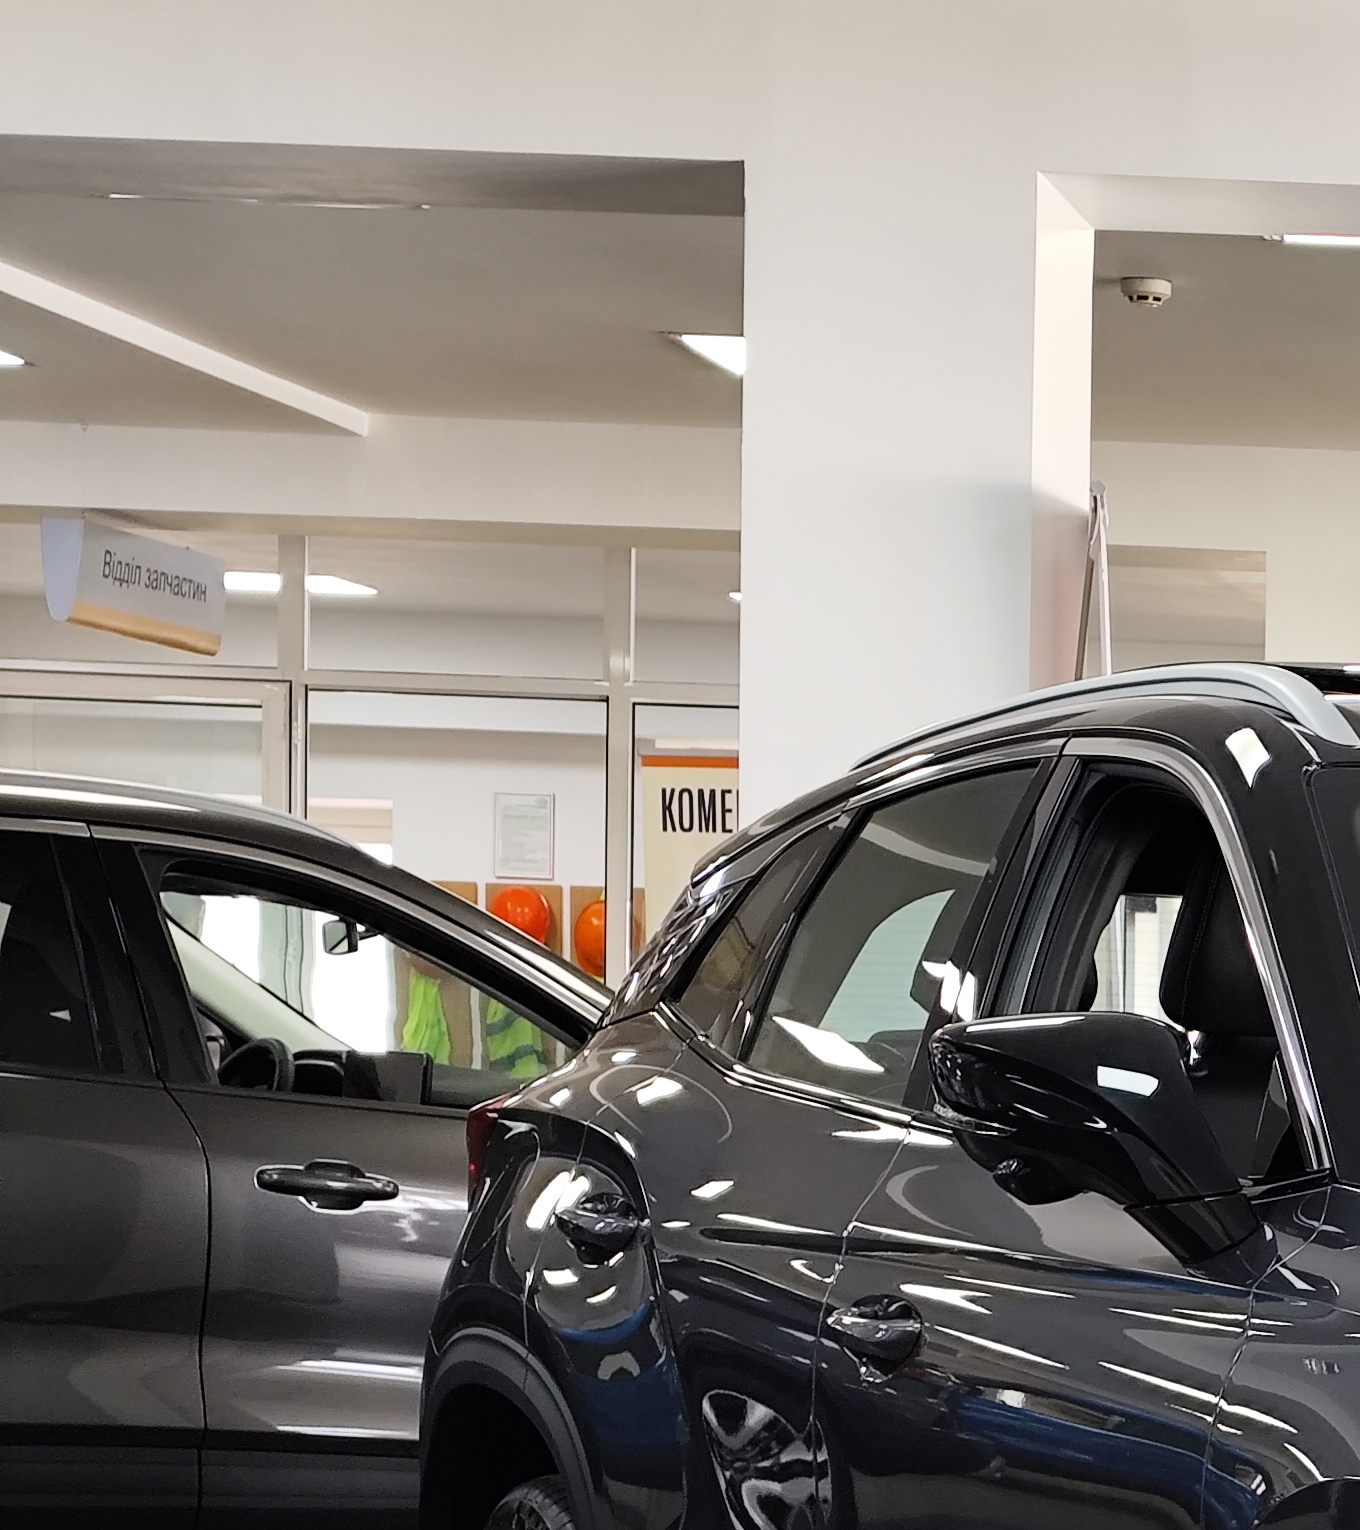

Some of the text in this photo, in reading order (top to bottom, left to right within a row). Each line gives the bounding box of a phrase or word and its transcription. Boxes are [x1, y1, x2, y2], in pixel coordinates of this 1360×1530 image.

[102, 549, 207, 603] Відділ запчастин
[661, 787, 739, 833] КОМЕ
